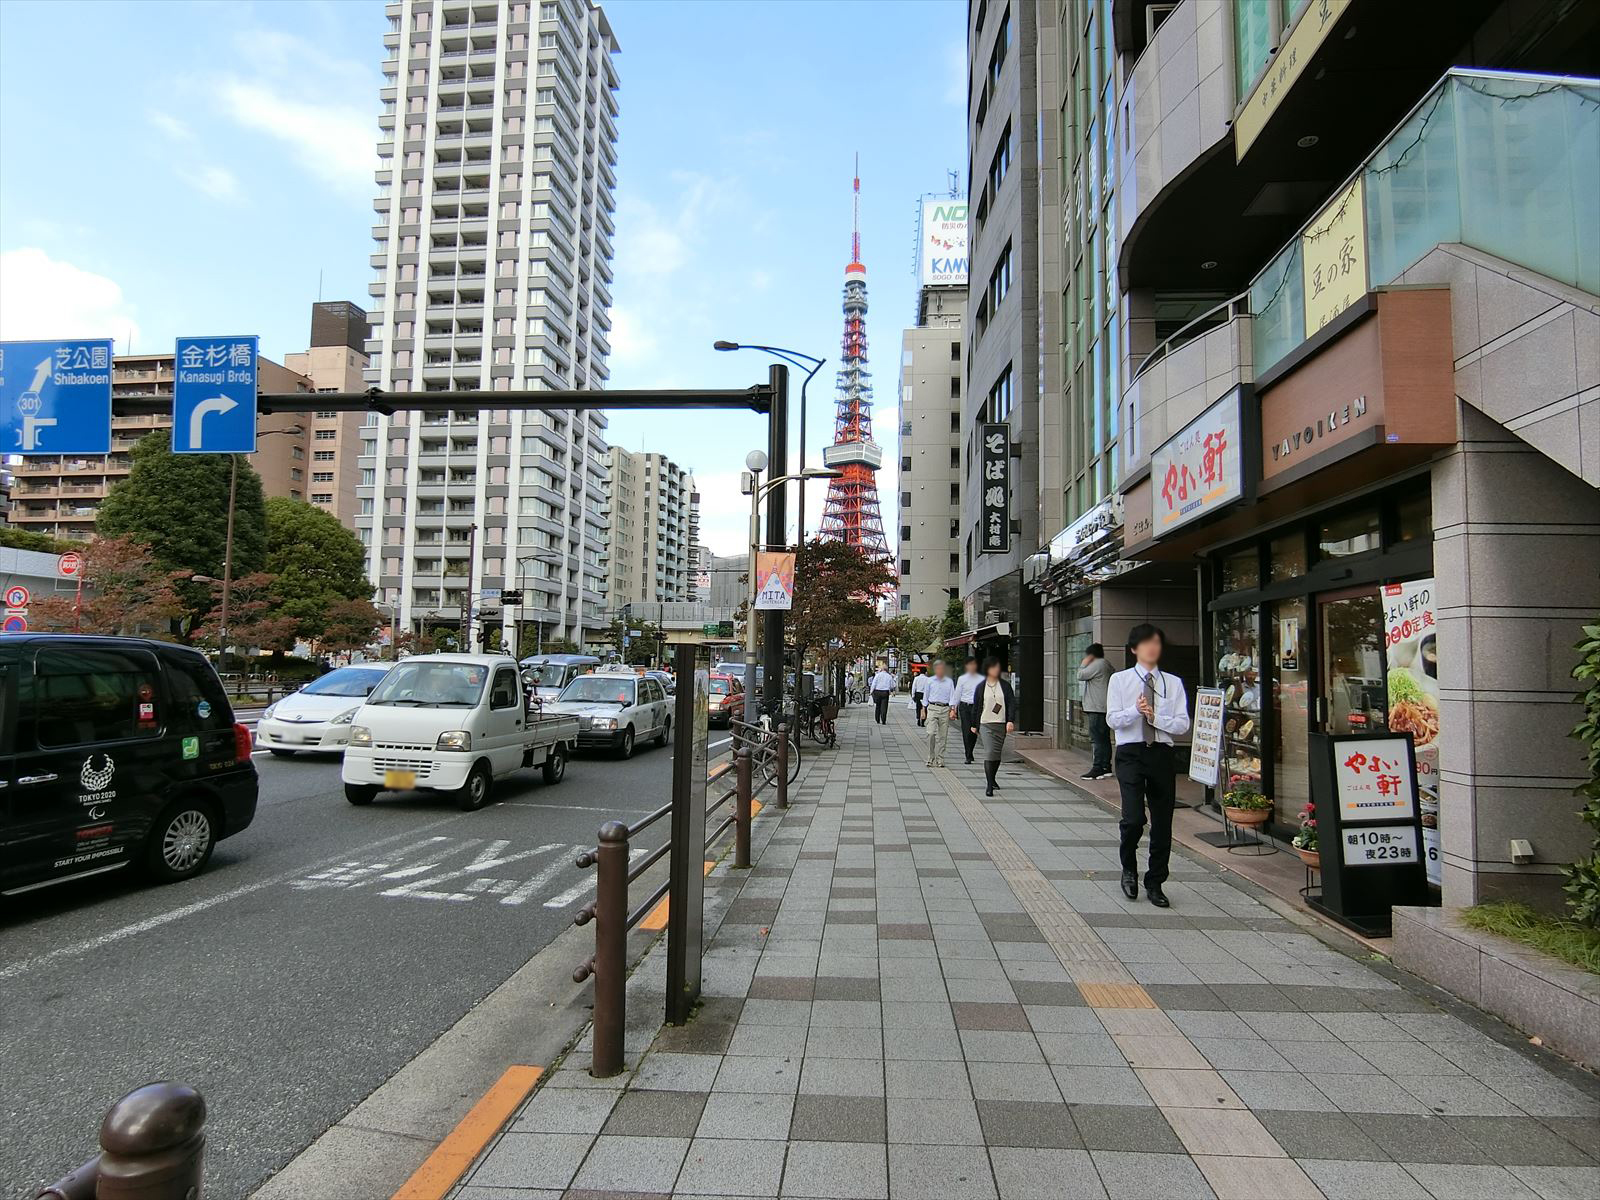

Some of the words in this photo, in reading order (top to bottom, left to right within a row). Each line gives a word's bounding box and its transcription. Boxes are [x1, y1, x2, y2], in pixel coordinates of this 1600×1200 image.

[55, 346, 108, 370] 芝公園
[182, 343, 251, 368] 金杉橋
[54, 372, 109, 385] Shibakoen
[179, 370, 225, 386] Kanasugi
[227, 370, 254, 386] Brdg.
[21, 400, 40, 411] 301
[1272, 394, 1367, 461] YAYOIKEN
[985, 433, 1005, 508] そば処
[1162, 428, 1227, 510] やよい軒
[761, 590, 786, 600] MITA
[1344, 751, 1399, 774] やよい
[1376, 774, 1402, 796] 軒
[78, 794, 100, 803] TOKYO
[100, 790, 117, 800] 2020
[54, 857, 74, 868] START
[74, 853, 91, 863] YOUR
[91, 846, 125, 859] IMPOSSIBLE
[1365, 846, 1411, 860] 夜23時
